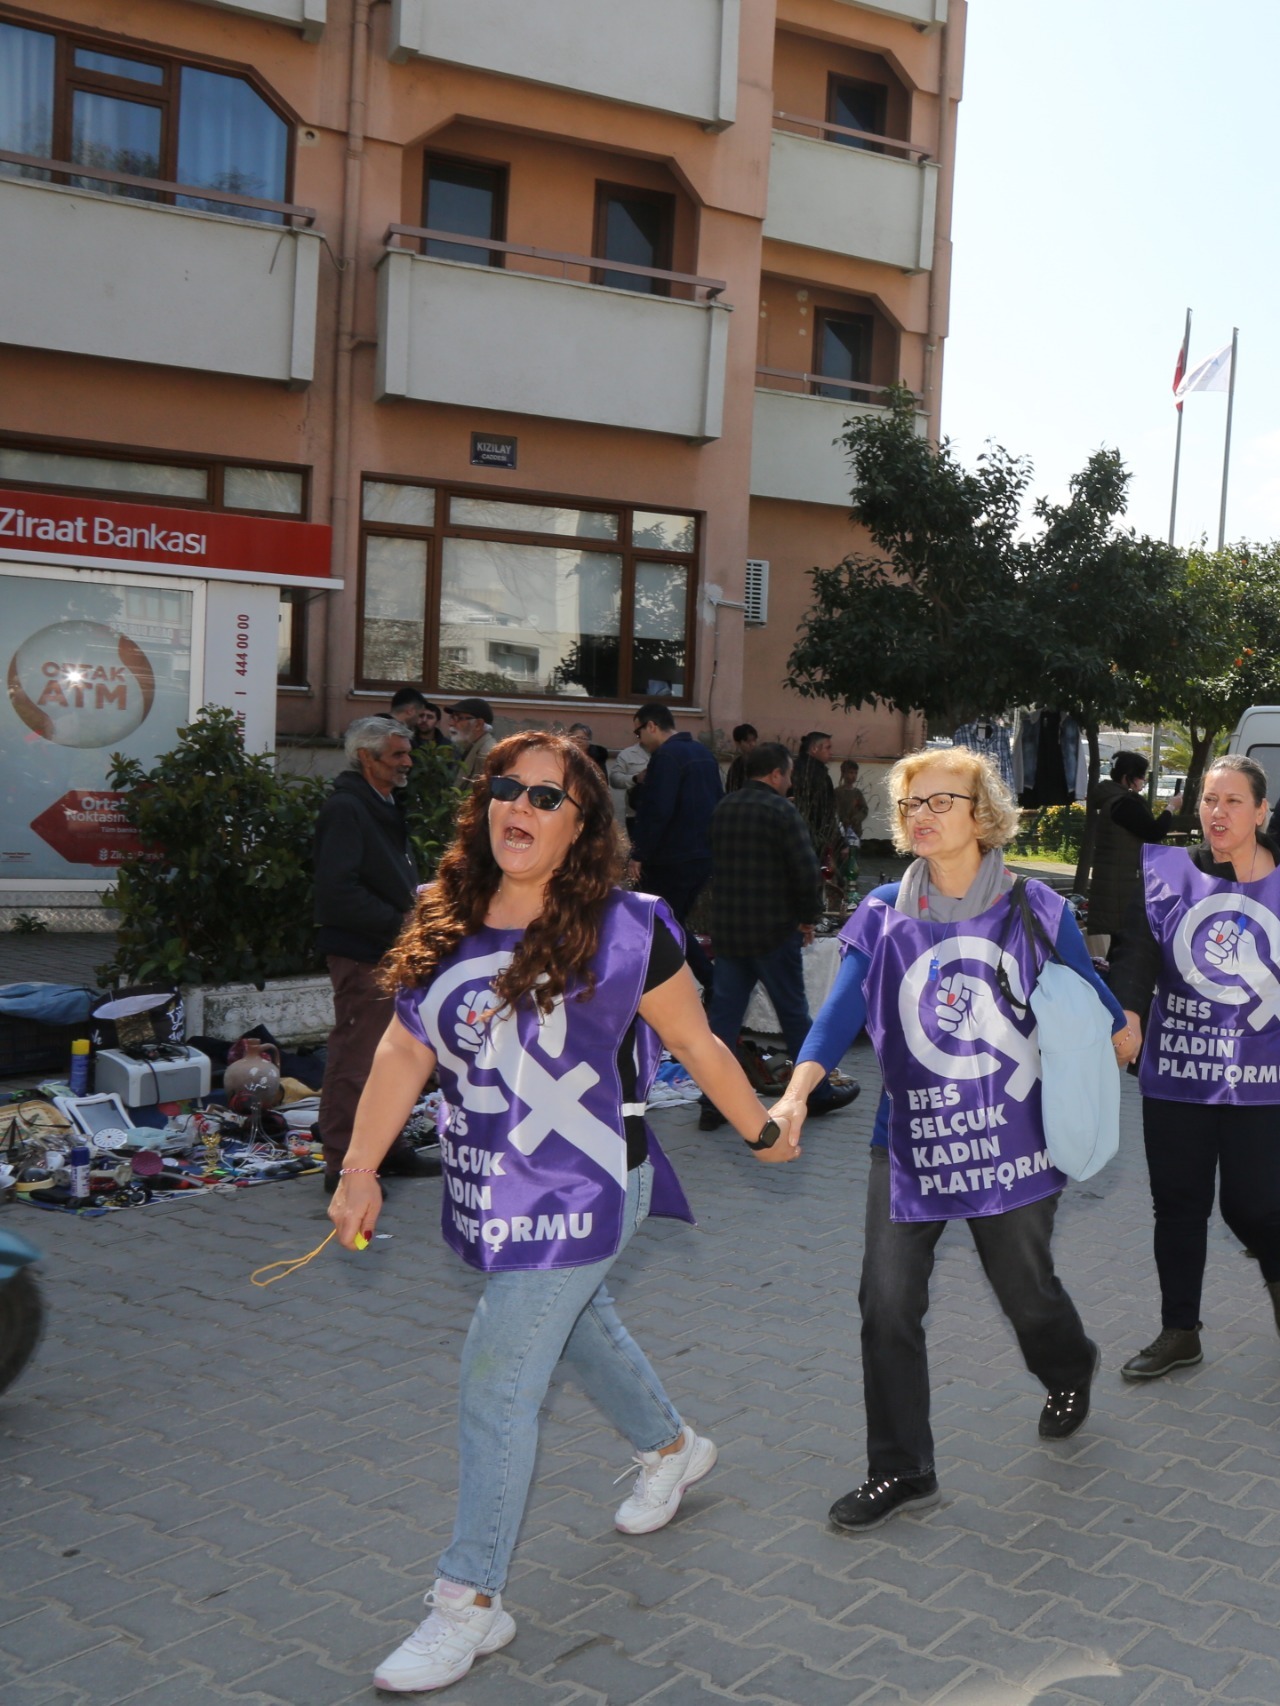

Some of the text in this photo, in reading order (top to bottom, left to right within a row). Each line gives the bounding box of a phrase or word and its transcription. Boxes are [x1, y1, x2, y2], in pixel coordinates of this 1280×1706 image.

[0, 507, 207, 555] Ziraat Bankası
[235, 614, 250, 676] 444 00 00
[37, 679, 127, 711] ATM
[1167, 993, 1211, 1019] EFES
[1160, 1033, 1234, 1058] KADIN
[907, 1084, 960, 1110] EFES
[911, 1104, 1008, 1139] SELÇUK
[912, 1136, 1001, 1168] KADIN
[918, 1148, 1055, 1196] PLATFORM
